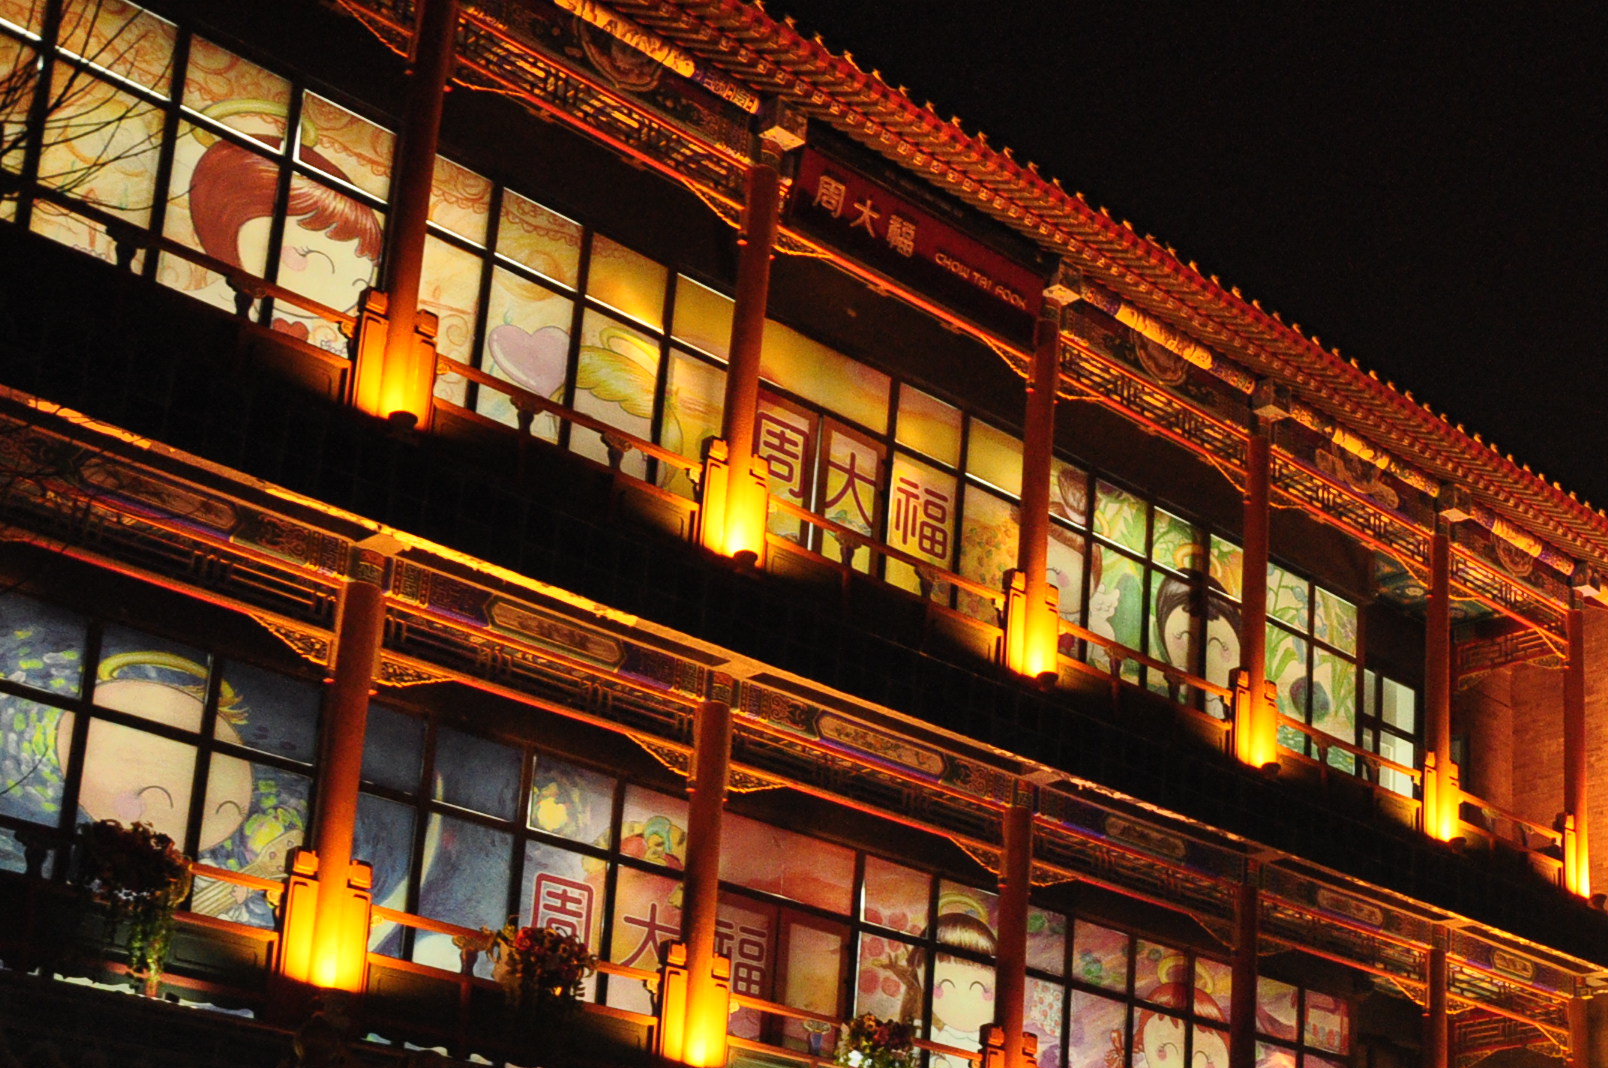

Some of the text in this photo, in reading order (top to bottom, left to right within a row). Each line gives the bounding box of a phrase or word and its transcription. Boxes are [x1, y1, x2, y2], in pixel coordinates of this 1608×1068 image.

[812, 174, 917, 258] 周大福
[935, 252, 1026, 309] CHOW TAI FOOK
[753, 410, 949, 560] 周大福
